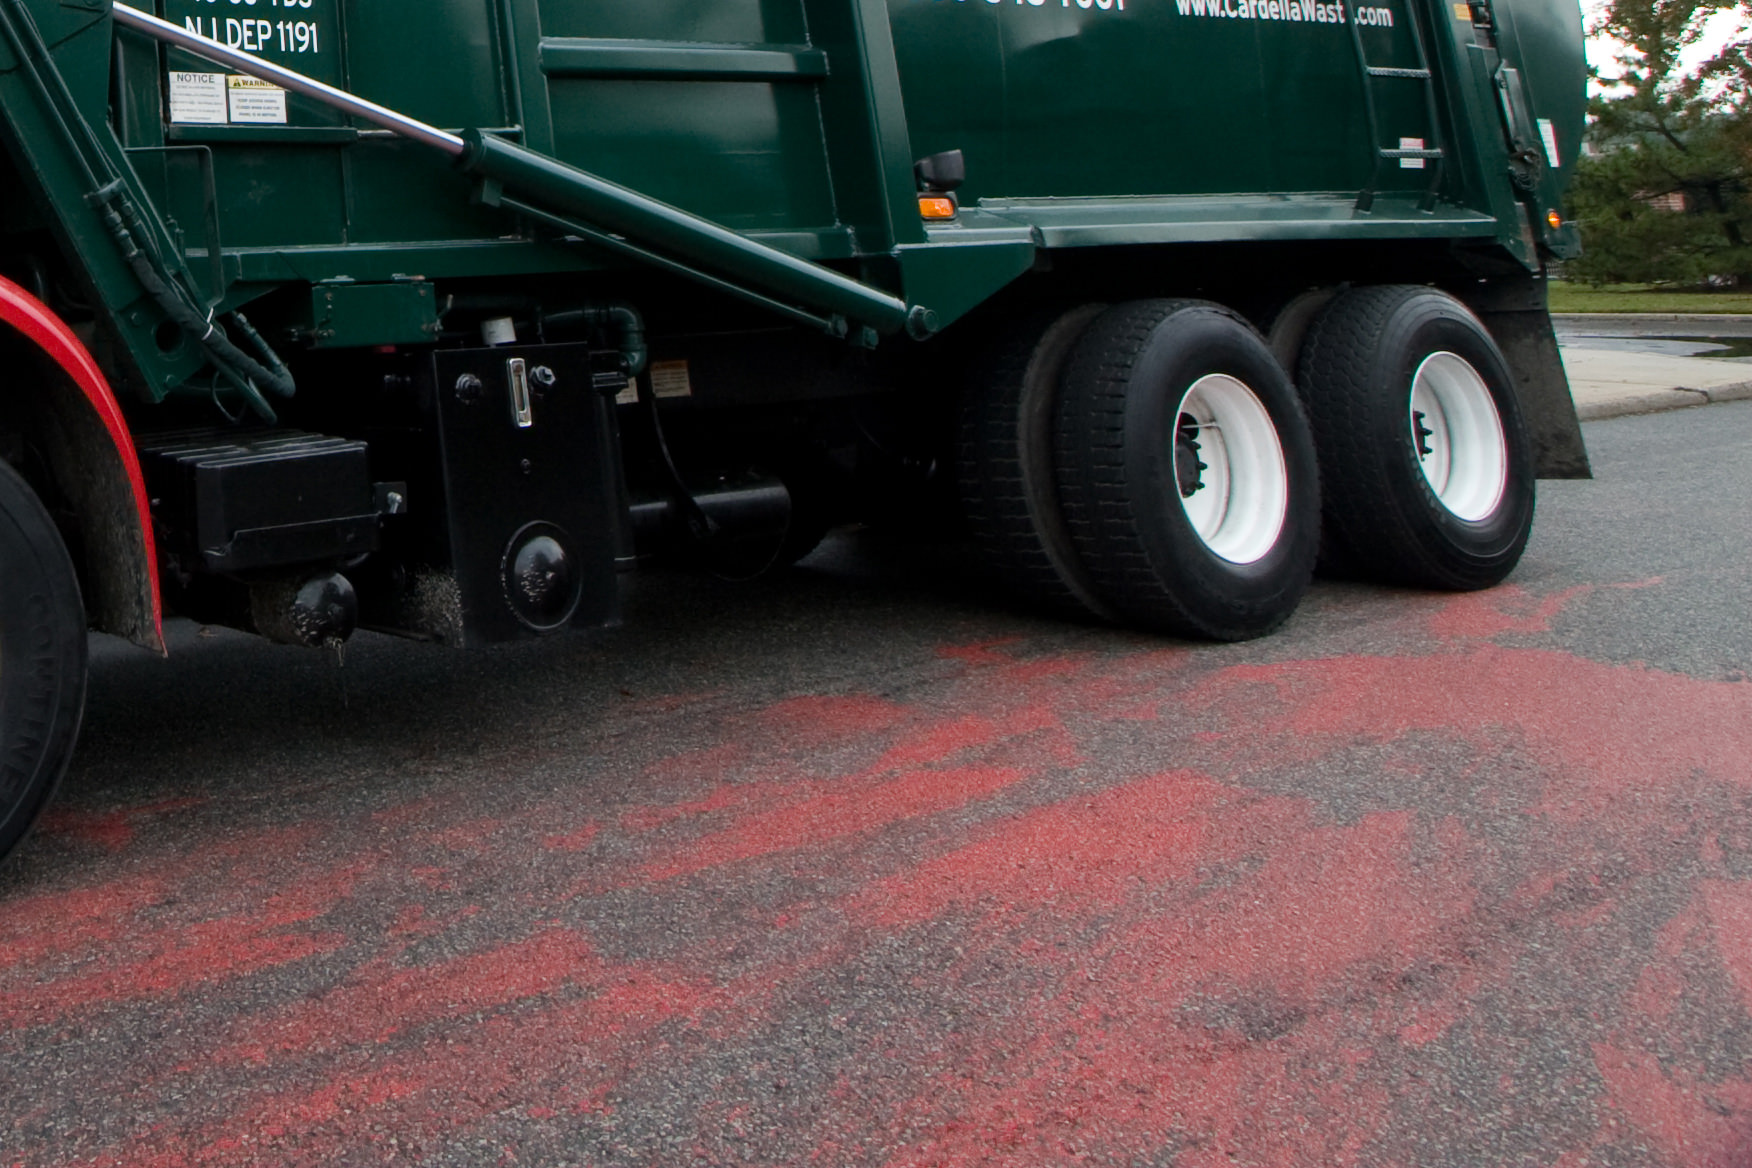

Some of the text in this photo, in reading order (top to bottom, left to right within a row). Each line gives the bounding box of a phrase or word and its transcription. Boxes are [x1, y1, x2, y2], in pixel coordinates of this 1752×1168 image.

[225, 18, 272, 51] DEP
[276, 20, 319, 53] 1191
[176, 73, 215, 84] NOTICE
